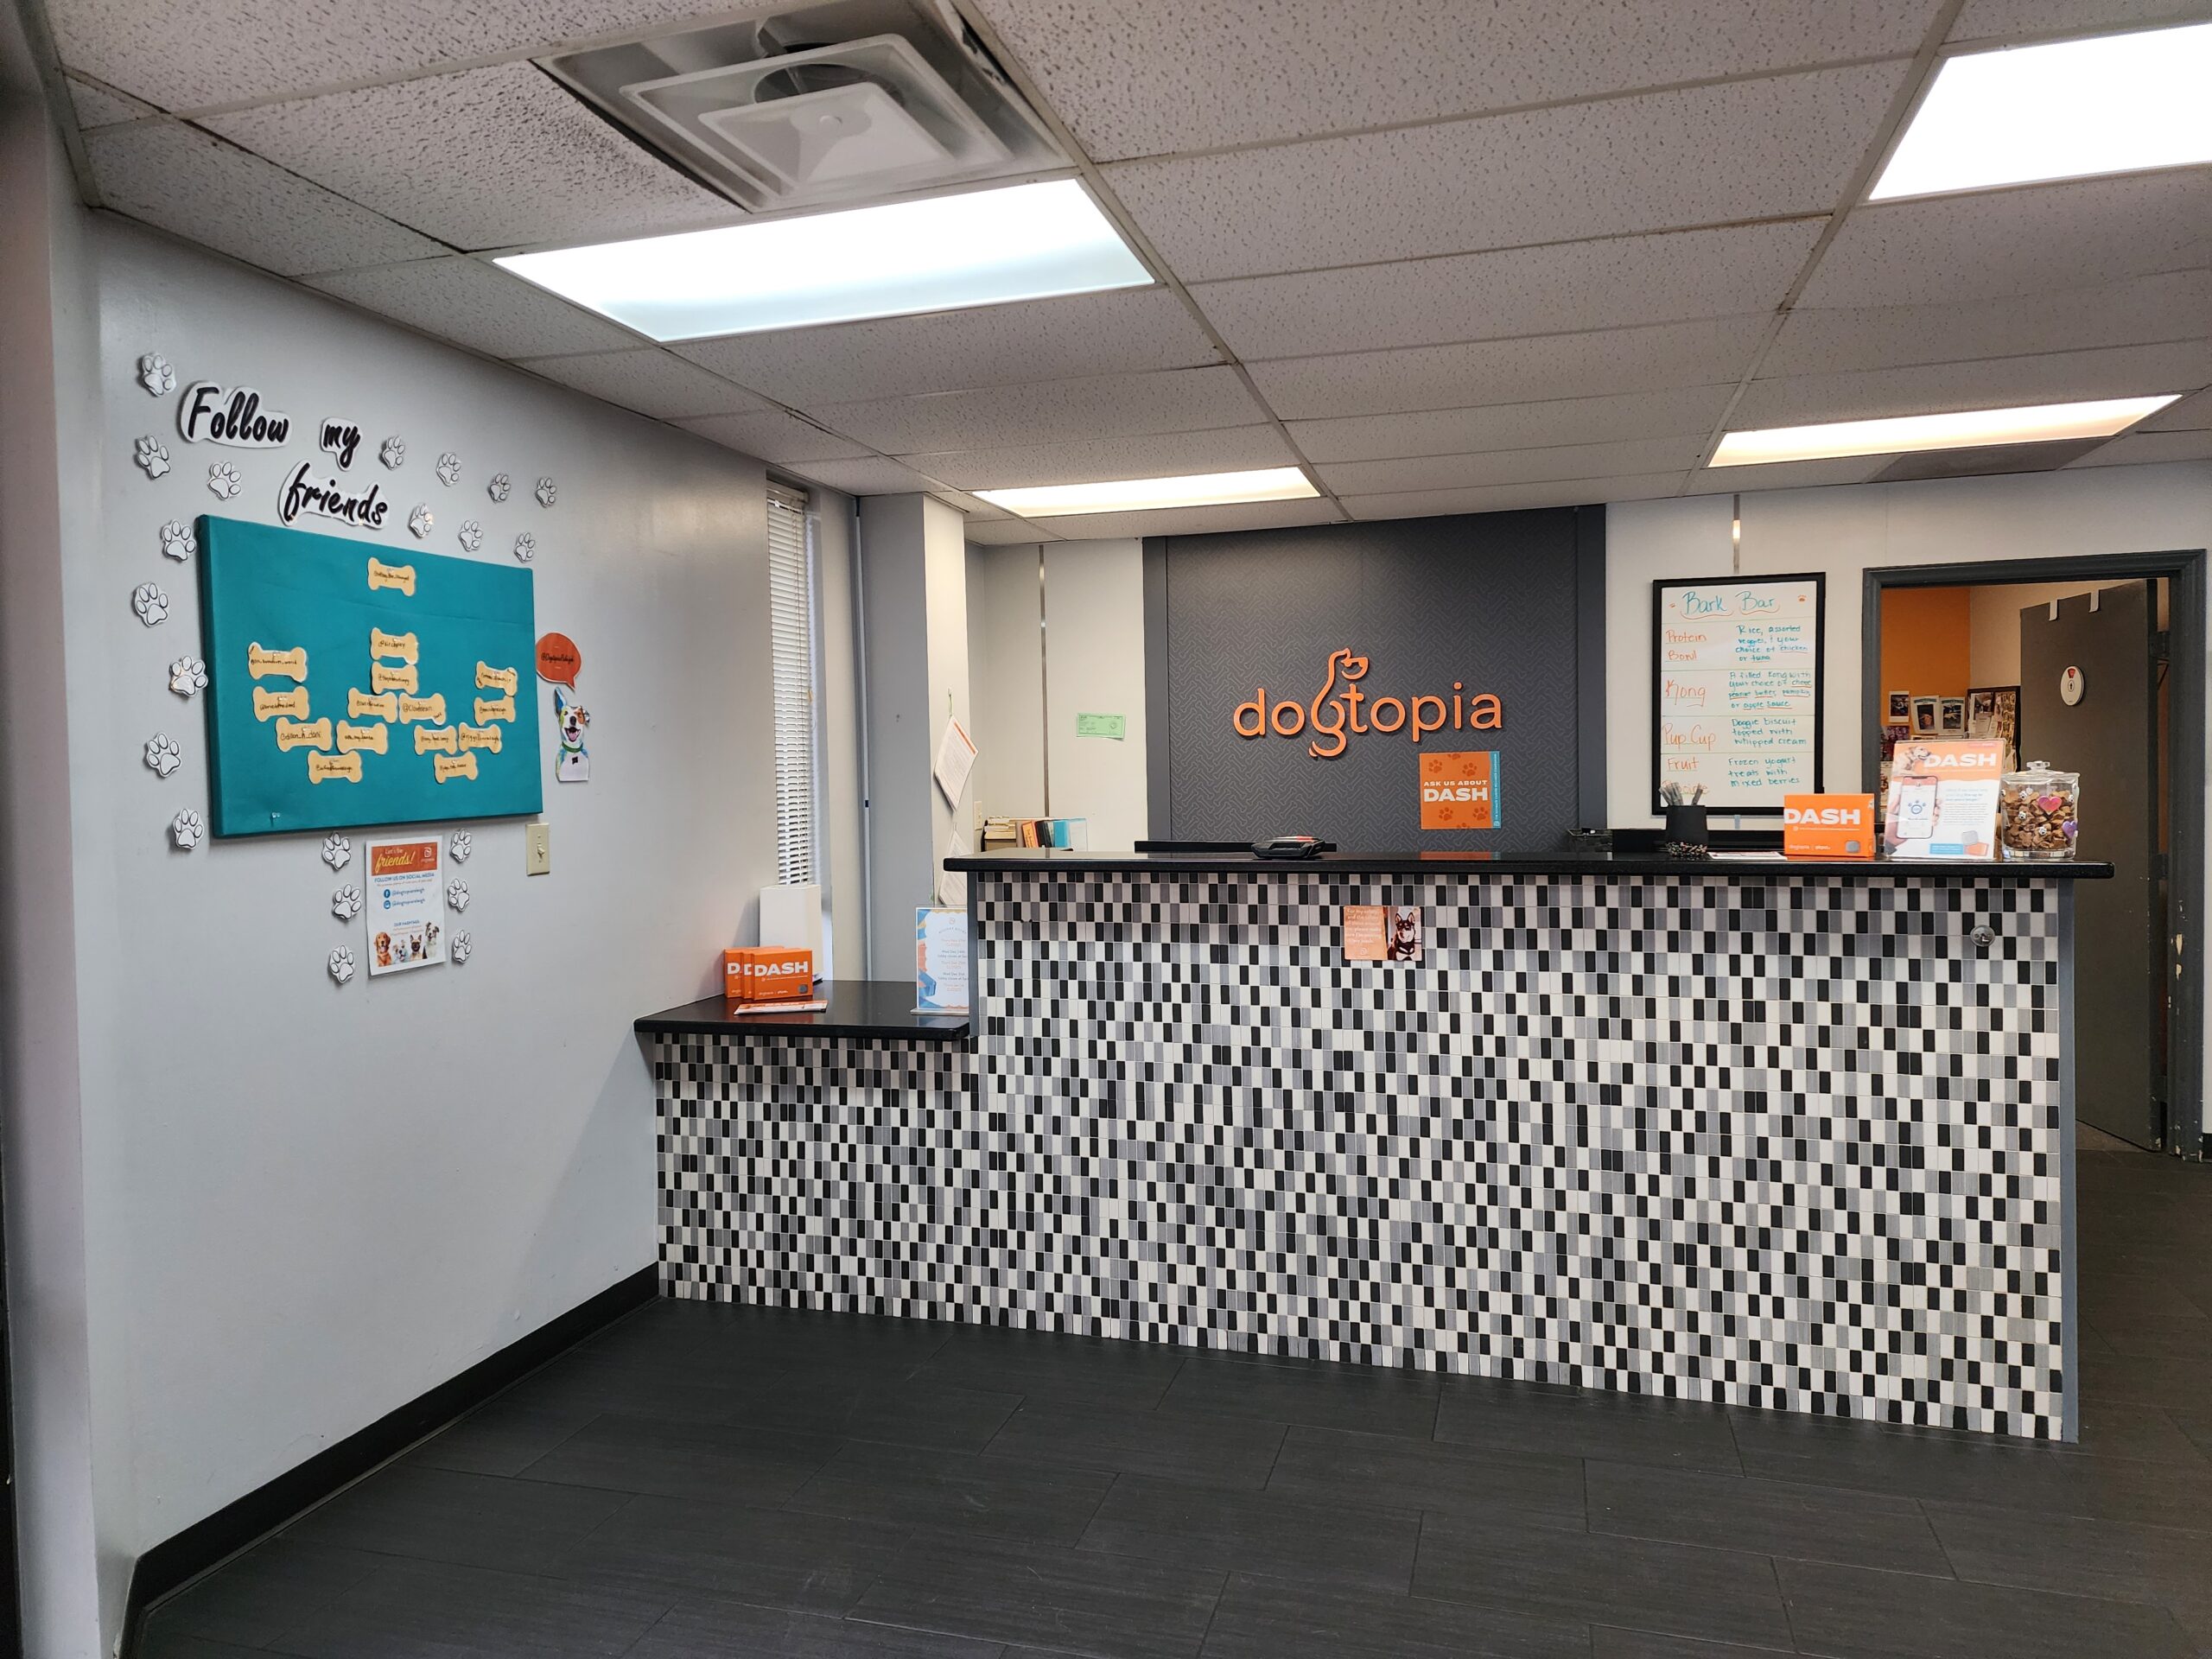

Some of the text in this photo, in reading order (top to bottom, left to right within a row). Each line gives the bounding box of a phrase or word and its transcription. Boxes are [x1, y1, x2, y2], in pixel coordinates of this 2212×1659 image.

[188, 386, 361, 469] Follow my
[283, 461, 389, 526] friends
[1681, 590, 1776, 615] Bark Bar
[1665, 629, 1707, 644] Protein
[1735, 625, 1764, 636] Rice,
[1777, 637, 1799, 646] your
[1666, 679, 1706, 707] Kong
[1729, 681, 1748, 691] your
[1233, 648, 1503, 757] dogtopia
[1732, 718, 1759, 729] Doggie
[1662, 722, 1716, 752] Pup Cup
[1732, 728, 1764, 737] topped
[1734, 738, 1774, 748] whipped
[1668, 757, 1700, 771] Fruit
[1764, 757, 1796, 768] yogurt
[1924, 753, 1997, 768] DASH
[1424, 787, 1488, 802] DASH
[1783, 808, 1860, 825] DASH
[375, 850, 416, 874] friends!
[754, 961, 809, 977] DASH
